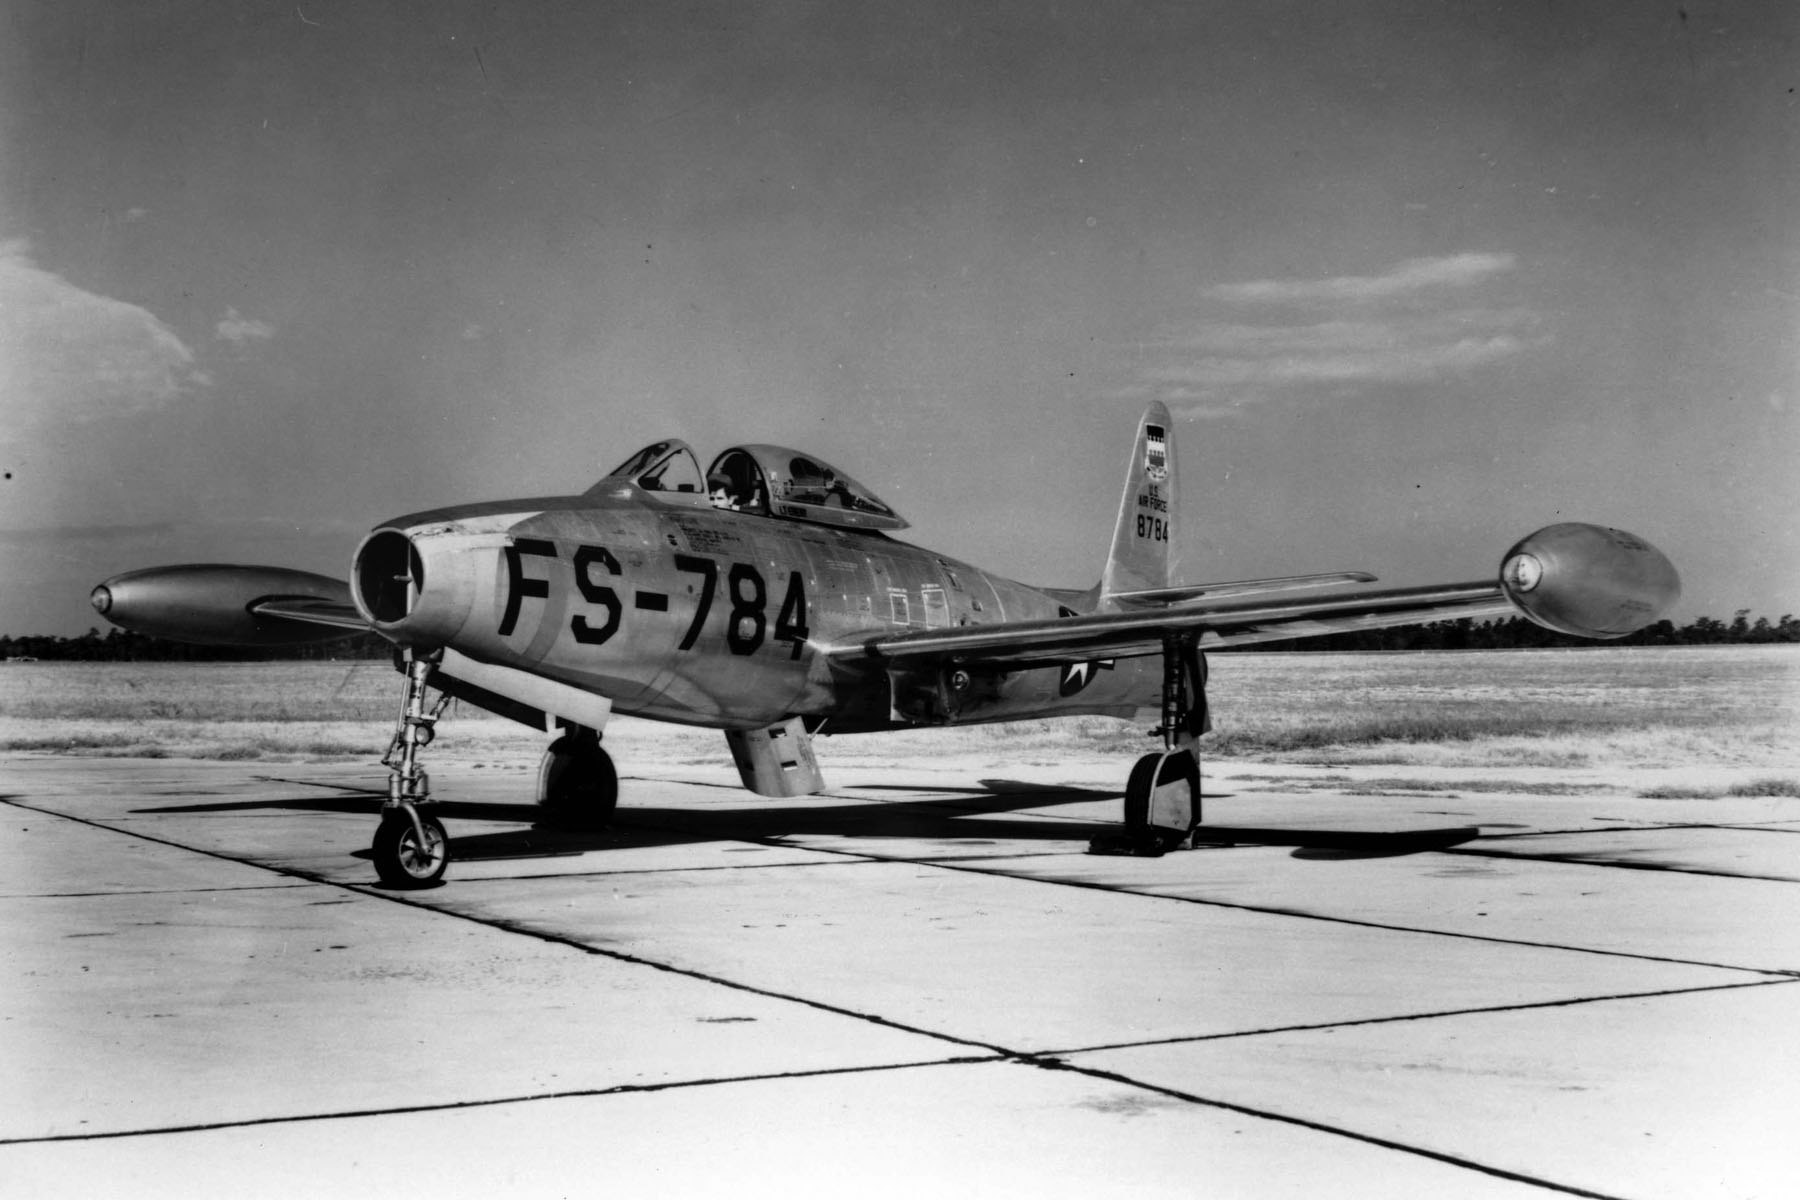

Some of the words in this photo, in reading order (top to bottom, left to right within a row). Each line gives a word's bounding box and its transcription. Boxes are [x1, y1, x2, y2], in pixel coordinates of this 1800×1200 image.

[1138, 495, 1149, 508] AIR
[1150, 496, 1168, 513] FORCE
[1137, 514, 1168, 544] 8784
[498, 537, 810, 660] FS-784
